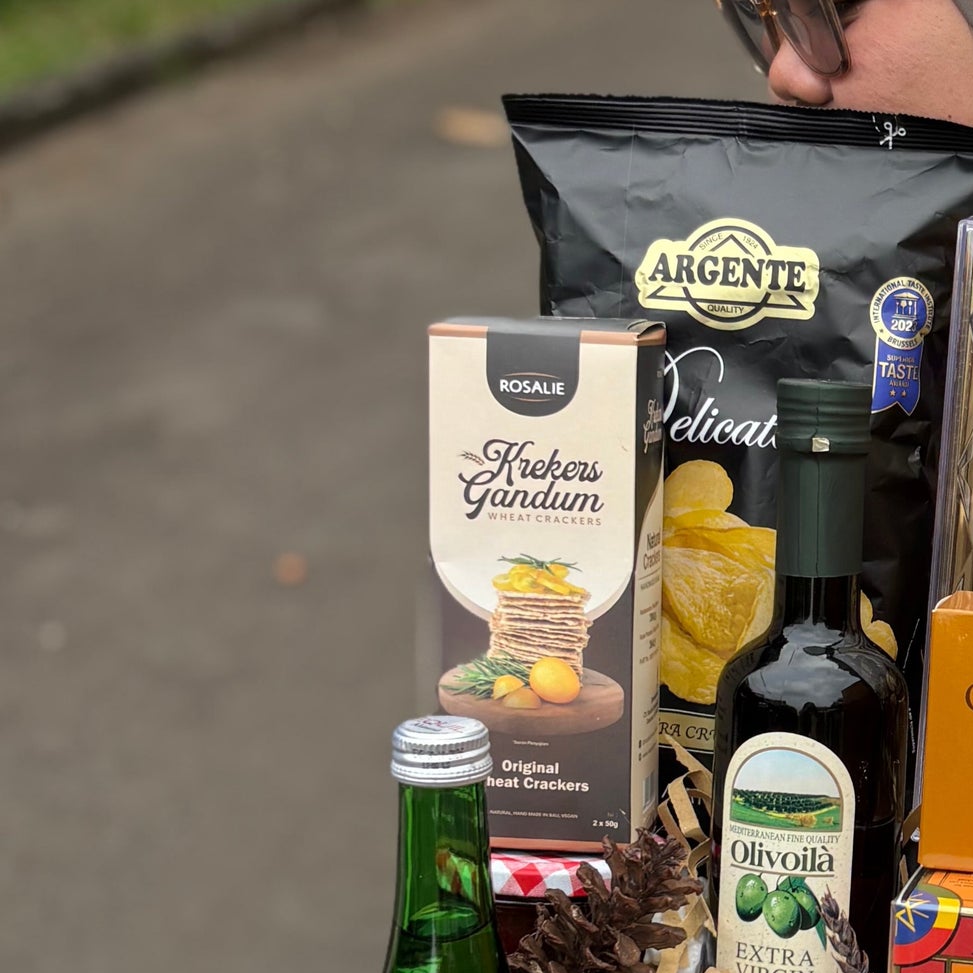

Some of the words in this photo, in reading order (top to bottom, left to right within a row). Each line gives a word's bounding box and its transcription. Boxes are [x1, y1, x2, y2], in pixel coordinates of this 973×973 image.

[699, 233, 723, 250] SINCE
[648, 253, 806, 293] ARGENTE
[707, 304, 744, 314] QUALITY
[872, 280, 906, 323] INTERNATIONAL
[908, 280, 925, 294] TASTE
[879, 362, 919, 380] TASTE
[500, 379, 565, 395] ROSALIE
[482, 438, 603, 487] Krekers
[458, 470, 604, 520] Gandum
[488, 512, 531, 522] WHEAT
[535, 515, 602, 526] CRACKERS
[502, 760, 559, 775] Original
[486, 776, 519, 788] heat
[523, 777, 589, 792] Crackers
[605, 820, 619, 829] 50g
[729, 824, 786, 842] MEDITERRANEAN
[787, 832, 805, 843] FINE
[805, 834, 841, 845] QUALITY
[731, 839, 835, 872] Olivoilà
[736, 941, 814, 967] EXTRA
